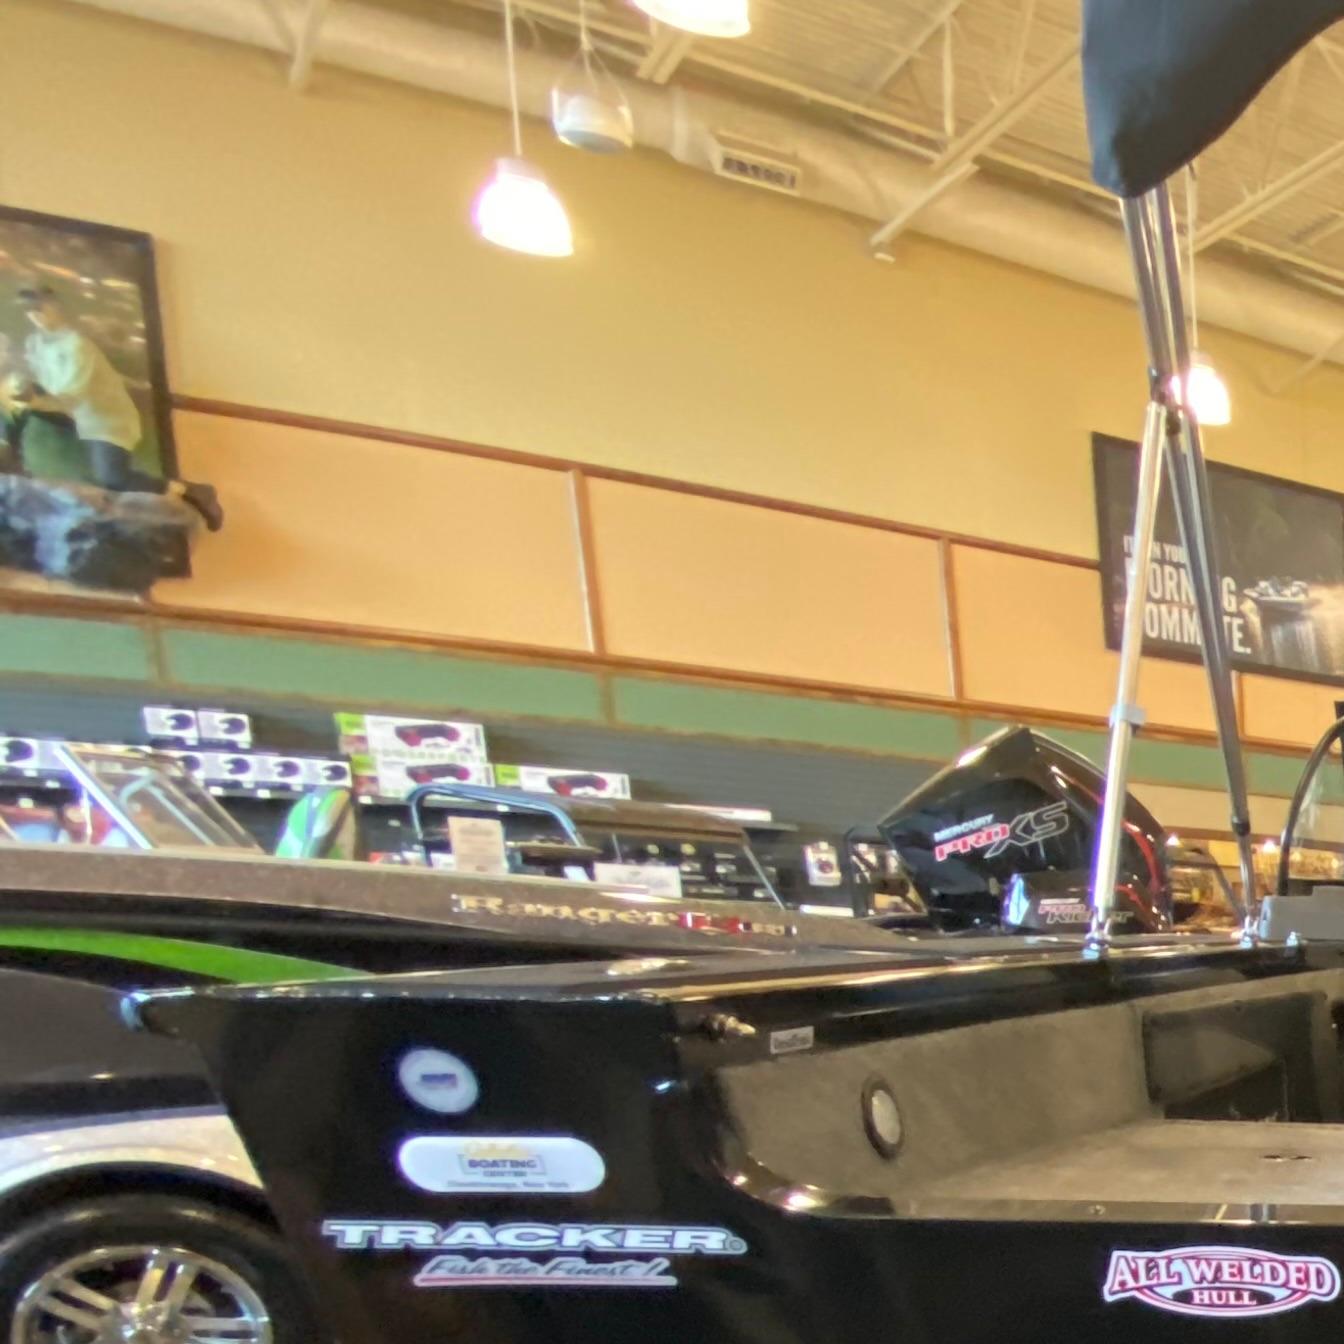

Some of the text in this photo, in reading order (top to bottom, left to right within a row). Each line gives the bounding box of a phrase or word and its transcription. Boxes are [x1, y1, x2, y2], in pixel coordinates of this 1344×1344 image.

[325, 1220, 732, 1254] TRACKER
[1110, 1254, 1336, 1298] ALL WELDED
[1190, 1289, 1257, 1306] HULL
